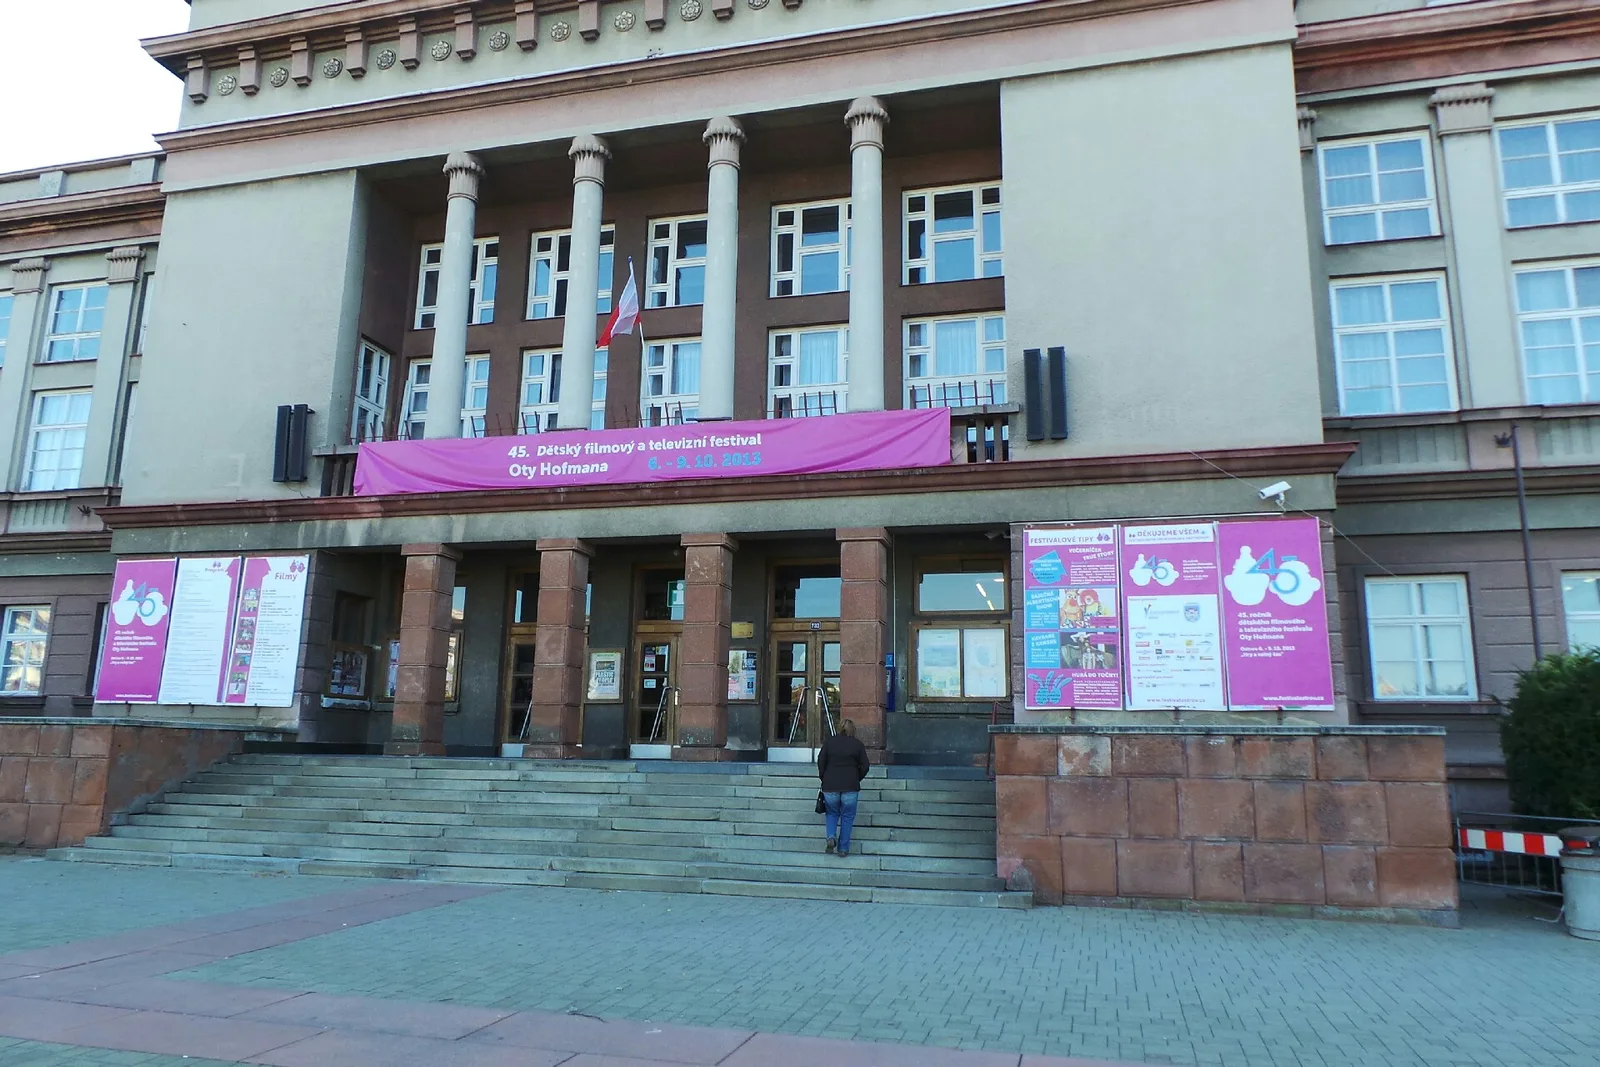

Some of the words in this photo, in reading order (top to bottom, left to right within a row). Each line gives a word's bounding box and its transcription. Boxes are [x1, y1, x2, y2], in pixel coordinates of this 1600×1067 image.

[508, 445, 529, 458] 45.
[537, 442, 581, 458] Dětský
[584, 440, 635, 455] filmový
[637, 442, 646, 451] a
[649, 436, 706, 450] televizní
[709, 433, 762, 447] festival
[508, 463, 537, 479] Oty
[540, 462, 609, 476] Hofmana
[648, 457, 661, 470] 6.
[676, 456, 691, 468] 9.
[694, 454, 718, 468] 10.
[722, 452, 762, 467] 2013
[1137, 529, 1178, 537] DĚKUJEME
[1030, 535, 1076, 544] FESTIVALOVÉ
[275, 572, 298, 582] Filmy
